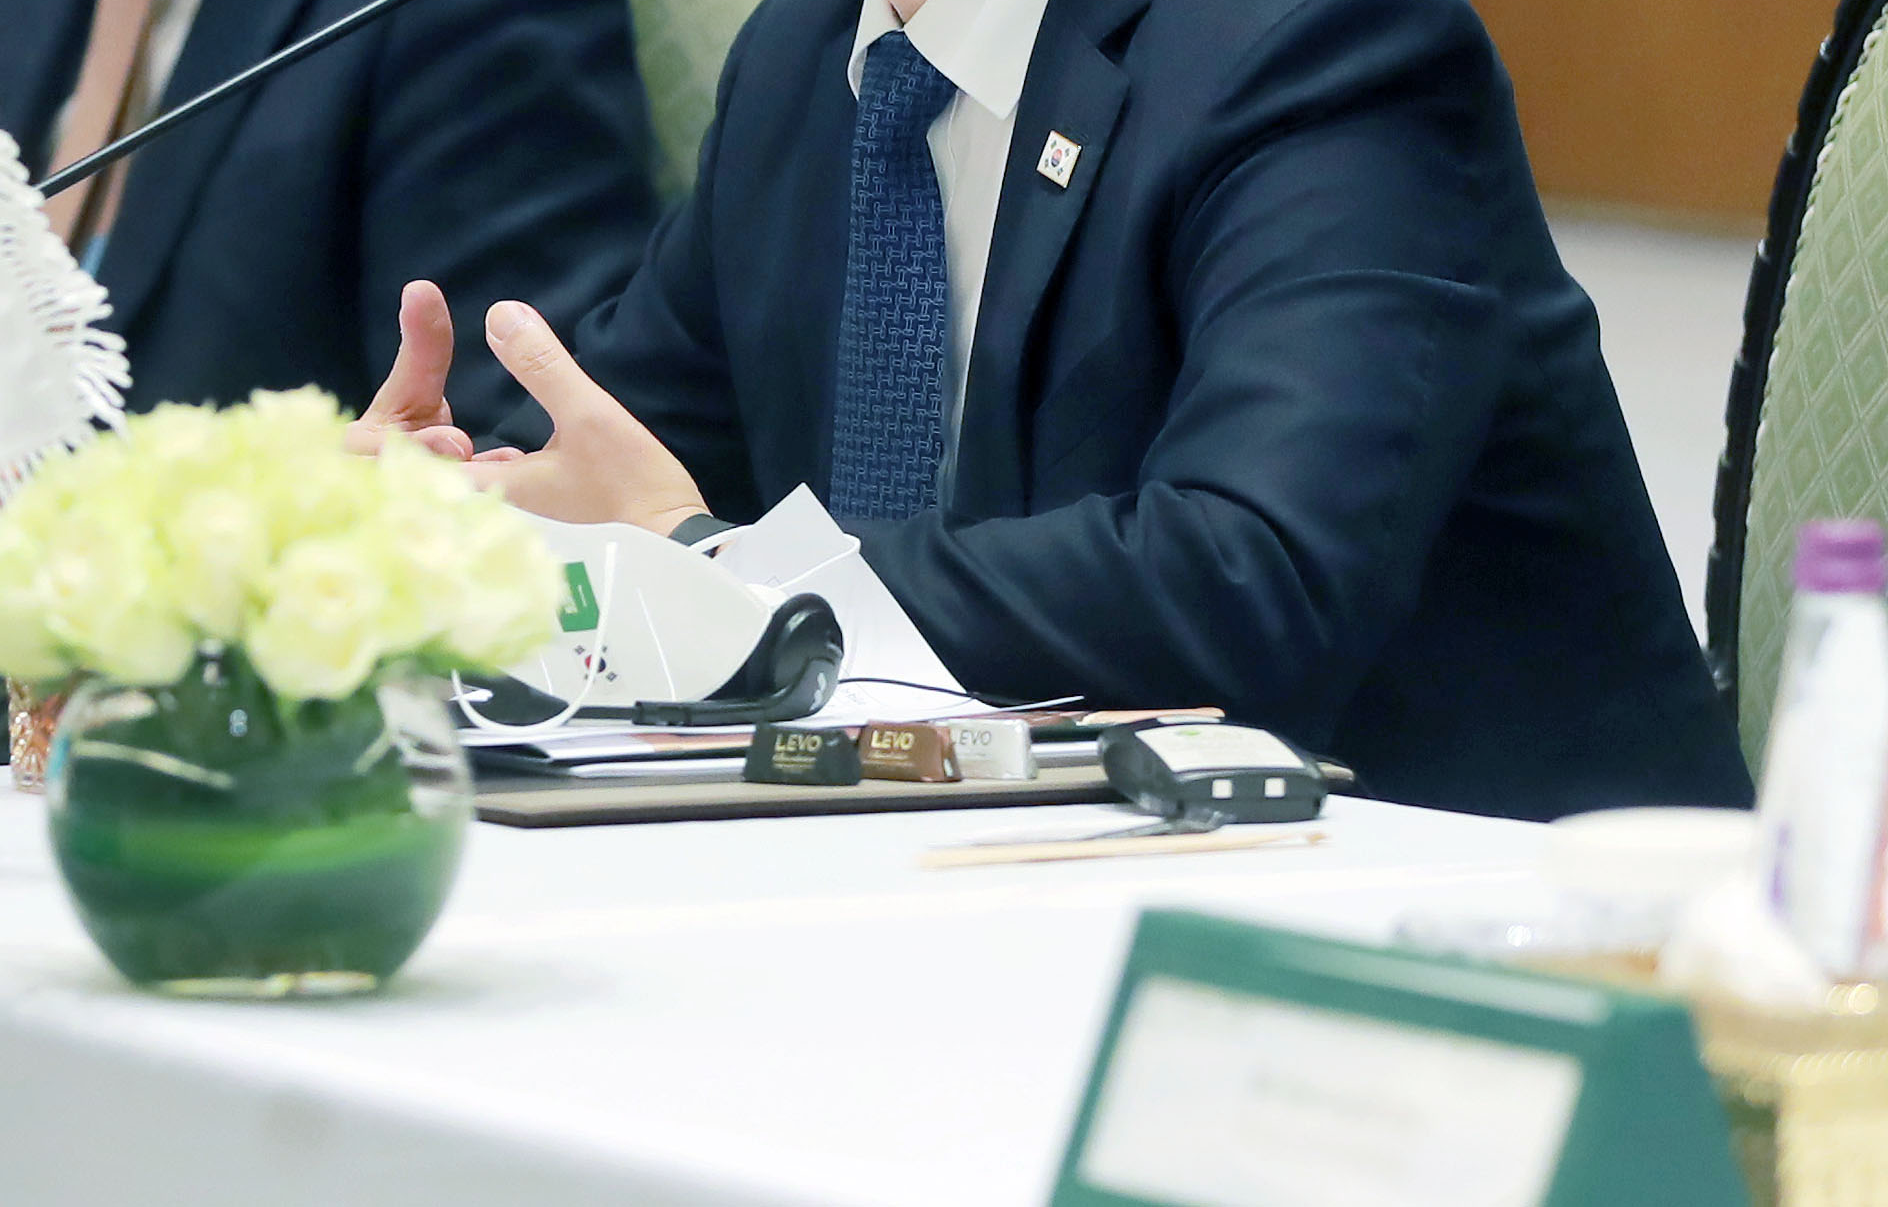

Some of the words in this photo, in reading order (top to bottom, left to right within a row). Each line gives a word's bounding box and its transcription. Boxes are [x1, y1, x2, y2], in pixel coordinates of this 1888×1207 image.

[774, 733, 823, 752] LEVO
[870, 729, 915, 751] LEVO
[953, 729, 992, 746] EVO
